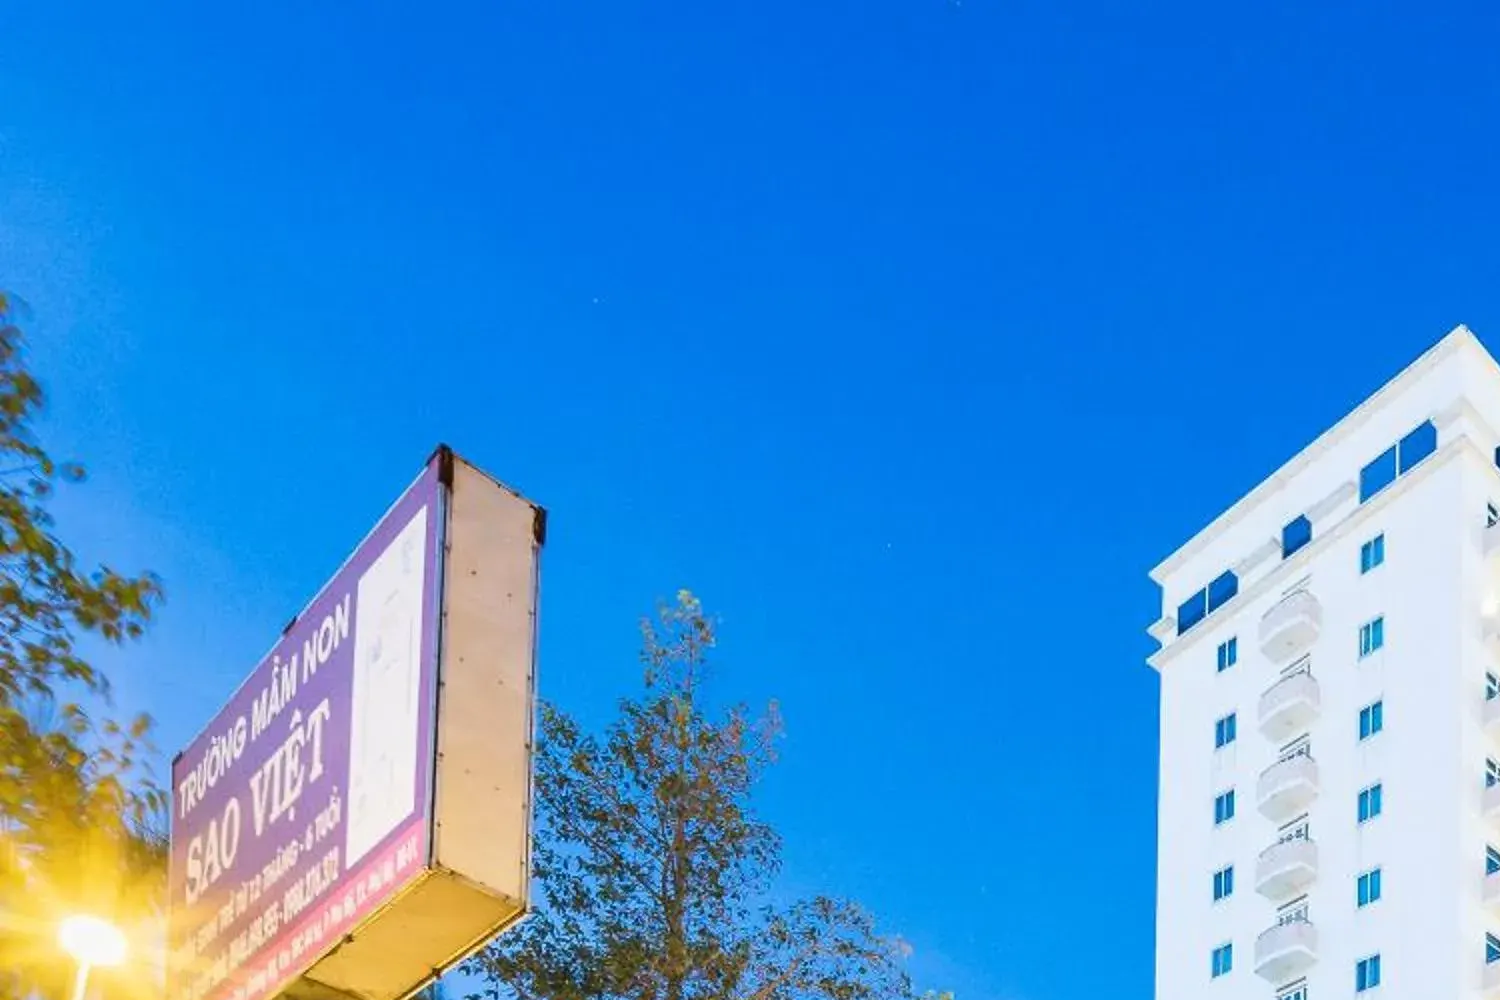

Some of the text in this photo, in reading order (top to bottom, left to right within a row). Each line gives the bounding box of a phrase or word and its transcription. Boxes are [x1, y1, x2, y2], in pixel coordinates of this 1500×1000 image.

[178, 592, 350, 820] TRƯỜNG MẦM NON
[185, 797, 241, 906] SAO
[249, 696, 330, 836] VIỆT
